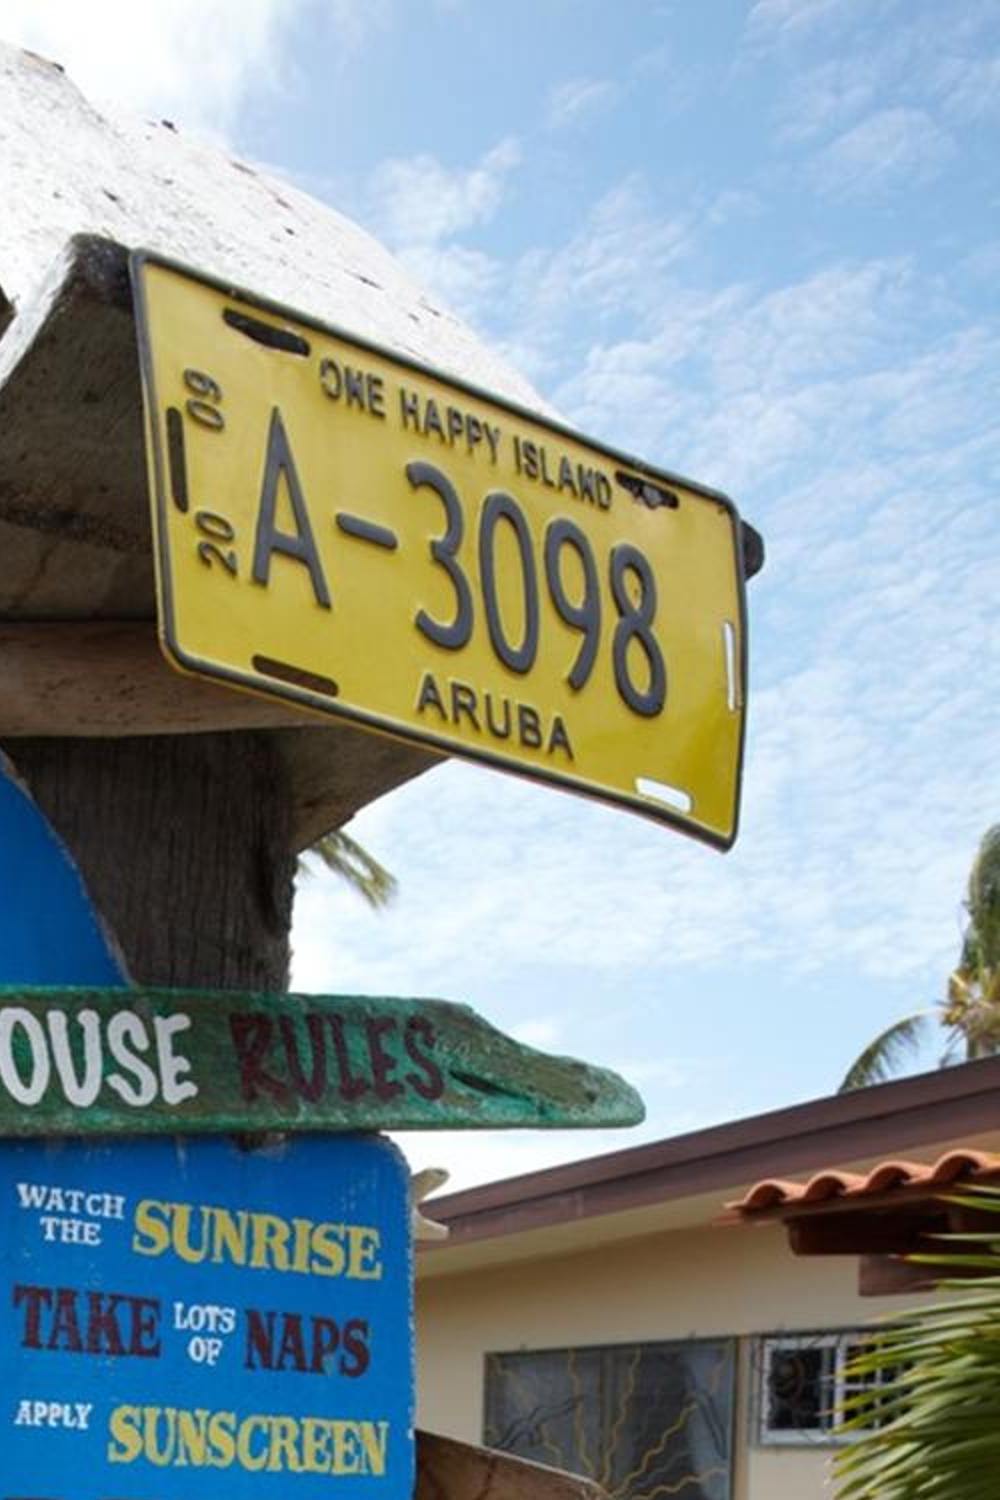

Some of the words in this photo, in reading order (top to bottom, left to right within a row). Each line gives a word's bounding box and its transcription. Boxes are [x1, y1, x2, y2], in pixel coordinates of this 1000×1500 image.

[320, 358, 386, 421] ONE
[399, 382, 501, 466] HAPPY
[514, 436, 613, 512] ISLAND
[251, 404, 667, 719] A-3098
[416, 673, 575, 760] ARUBA
[229, 1012, 447, 1105] RULES
[17, 1183, 126, 1219] WATCH
[40, 1217, 101, 1246] THE
[132, 1199, 382, 1280] SUNRISE
[12, 1283, 161, 1359] TAKE
[173, 1302, 236, 1332] LOTS
[188, 1339, 222, 1365] OF
[243, 1309, 372, 1378] NAPS
[13, 1401, 93, 1430] APPLY
[107, 1404, 390, 1477] SUNSCREEN
